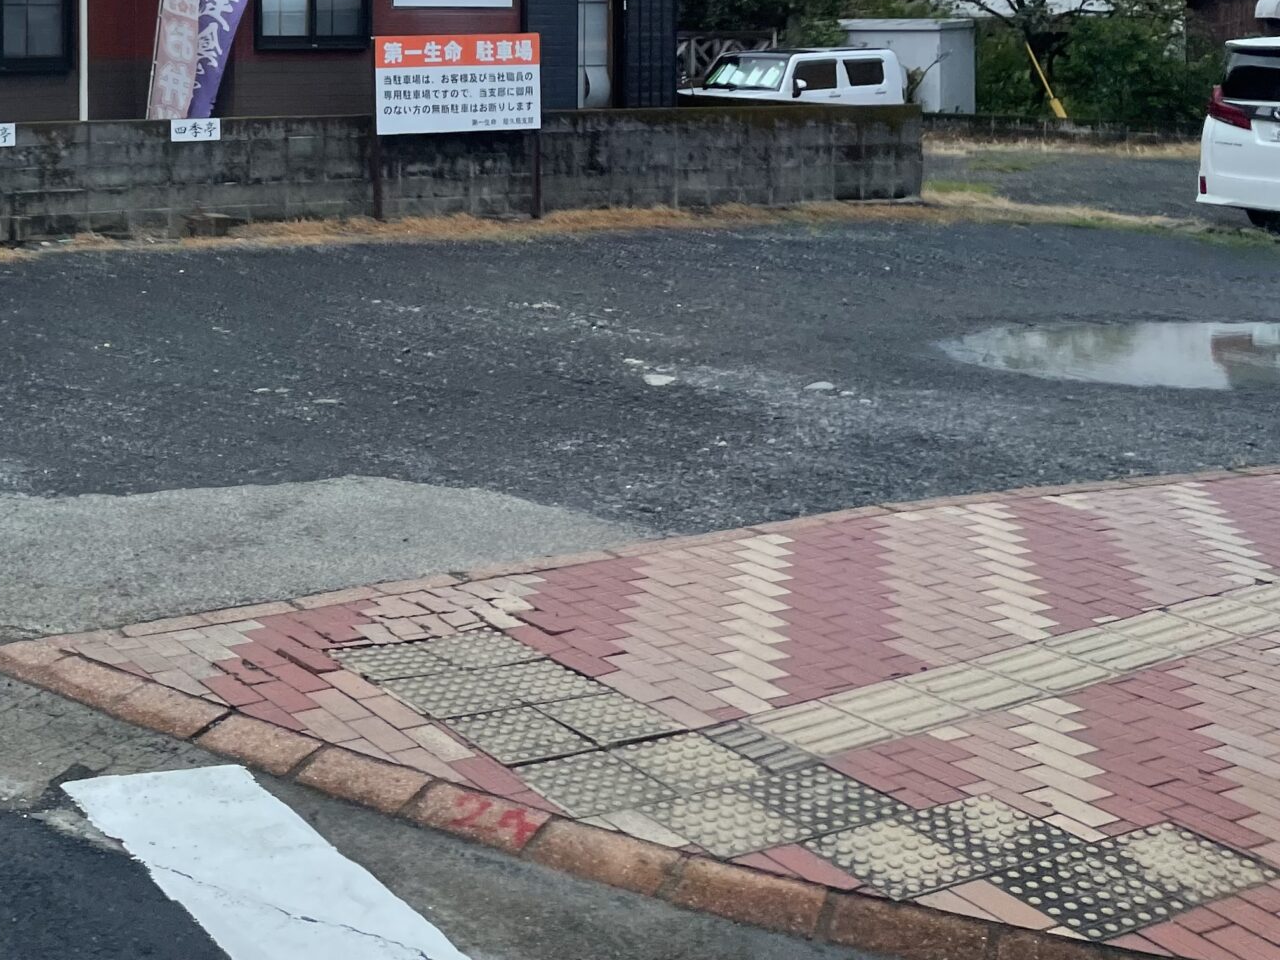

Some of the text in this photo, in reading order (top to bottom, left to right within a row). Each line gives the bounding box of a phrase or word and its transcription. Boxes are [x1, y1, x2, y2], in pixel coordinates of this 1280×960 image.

[383, 39, 533, 64] 第一生命 駐車場
[174, 121, 217, 138] 四季亭
